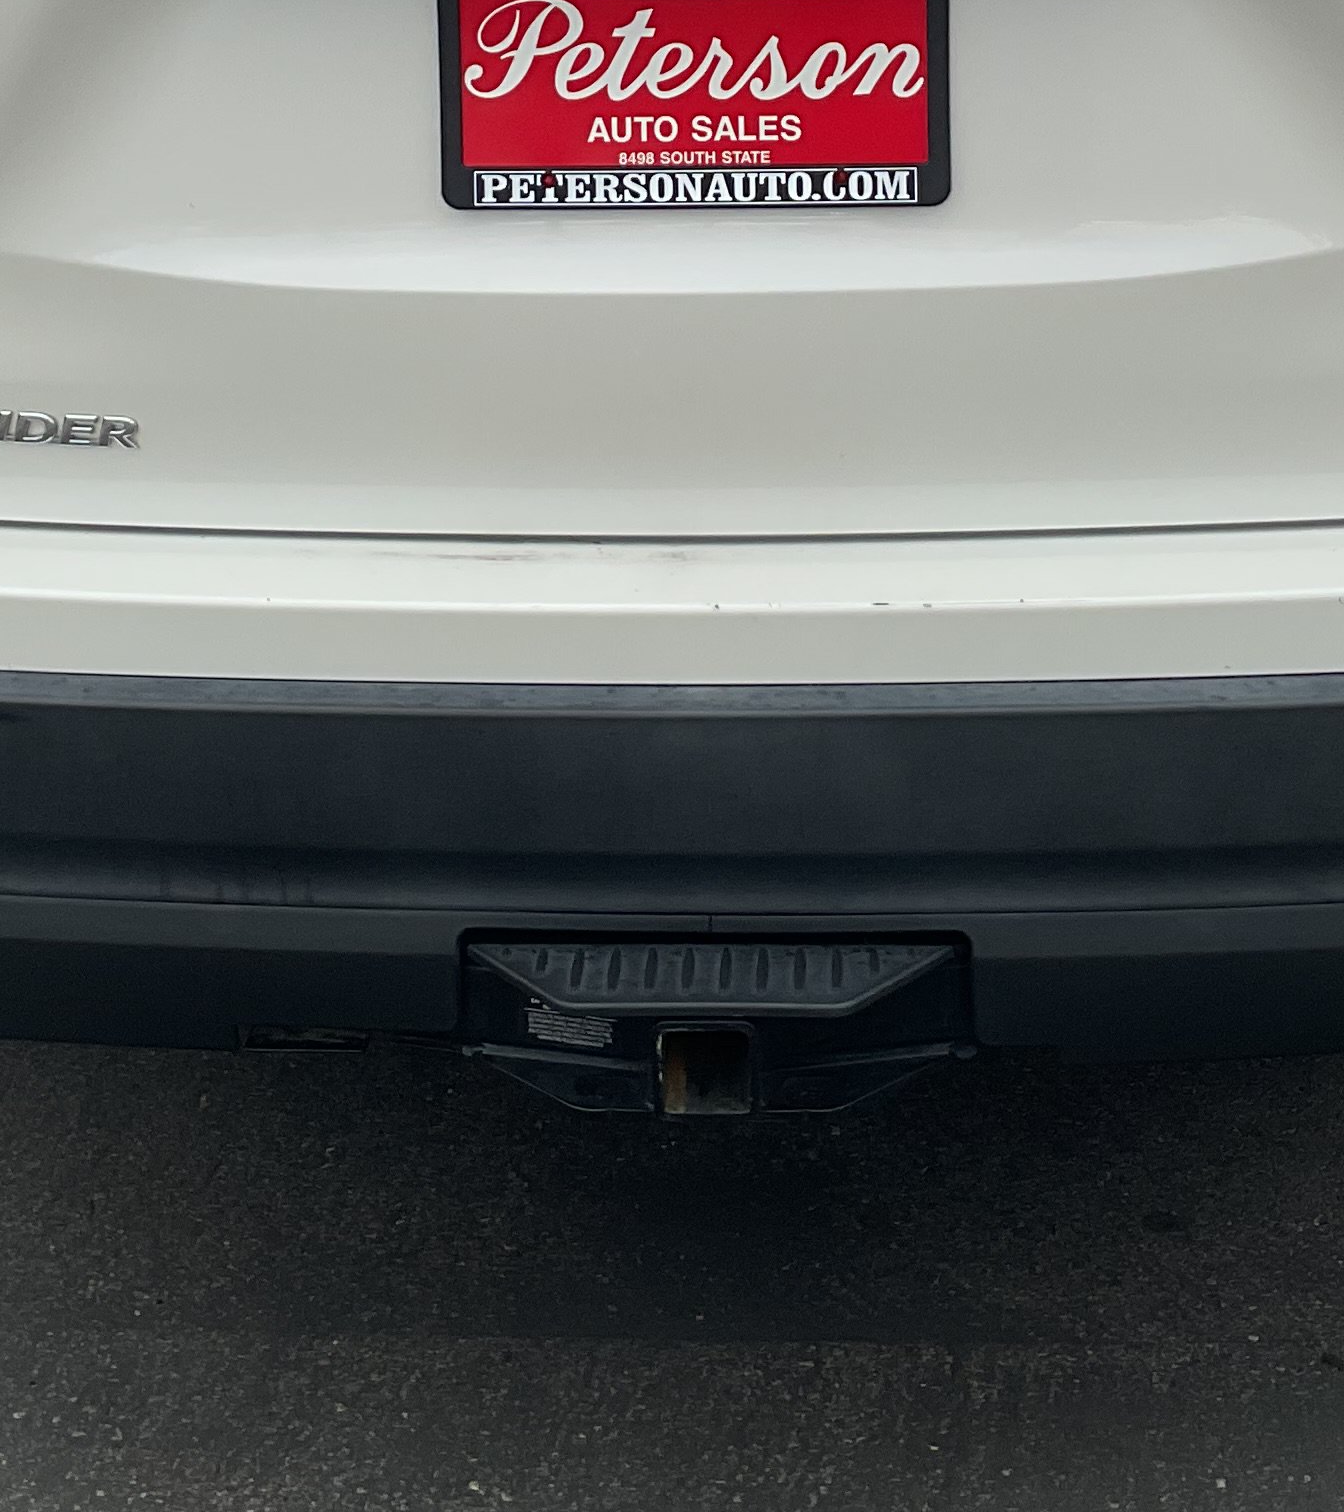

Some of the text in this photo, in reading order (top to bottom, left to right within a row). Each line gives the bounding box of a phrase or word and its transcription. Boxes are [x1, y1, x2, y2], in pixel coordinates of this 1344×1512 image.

[587, 114, 802, 143] AUTO SALES
[619, 150, 771, 166] 8498 SOUTH STATE
[481, 170, 910, 203] PETERSONAUTO.COM
